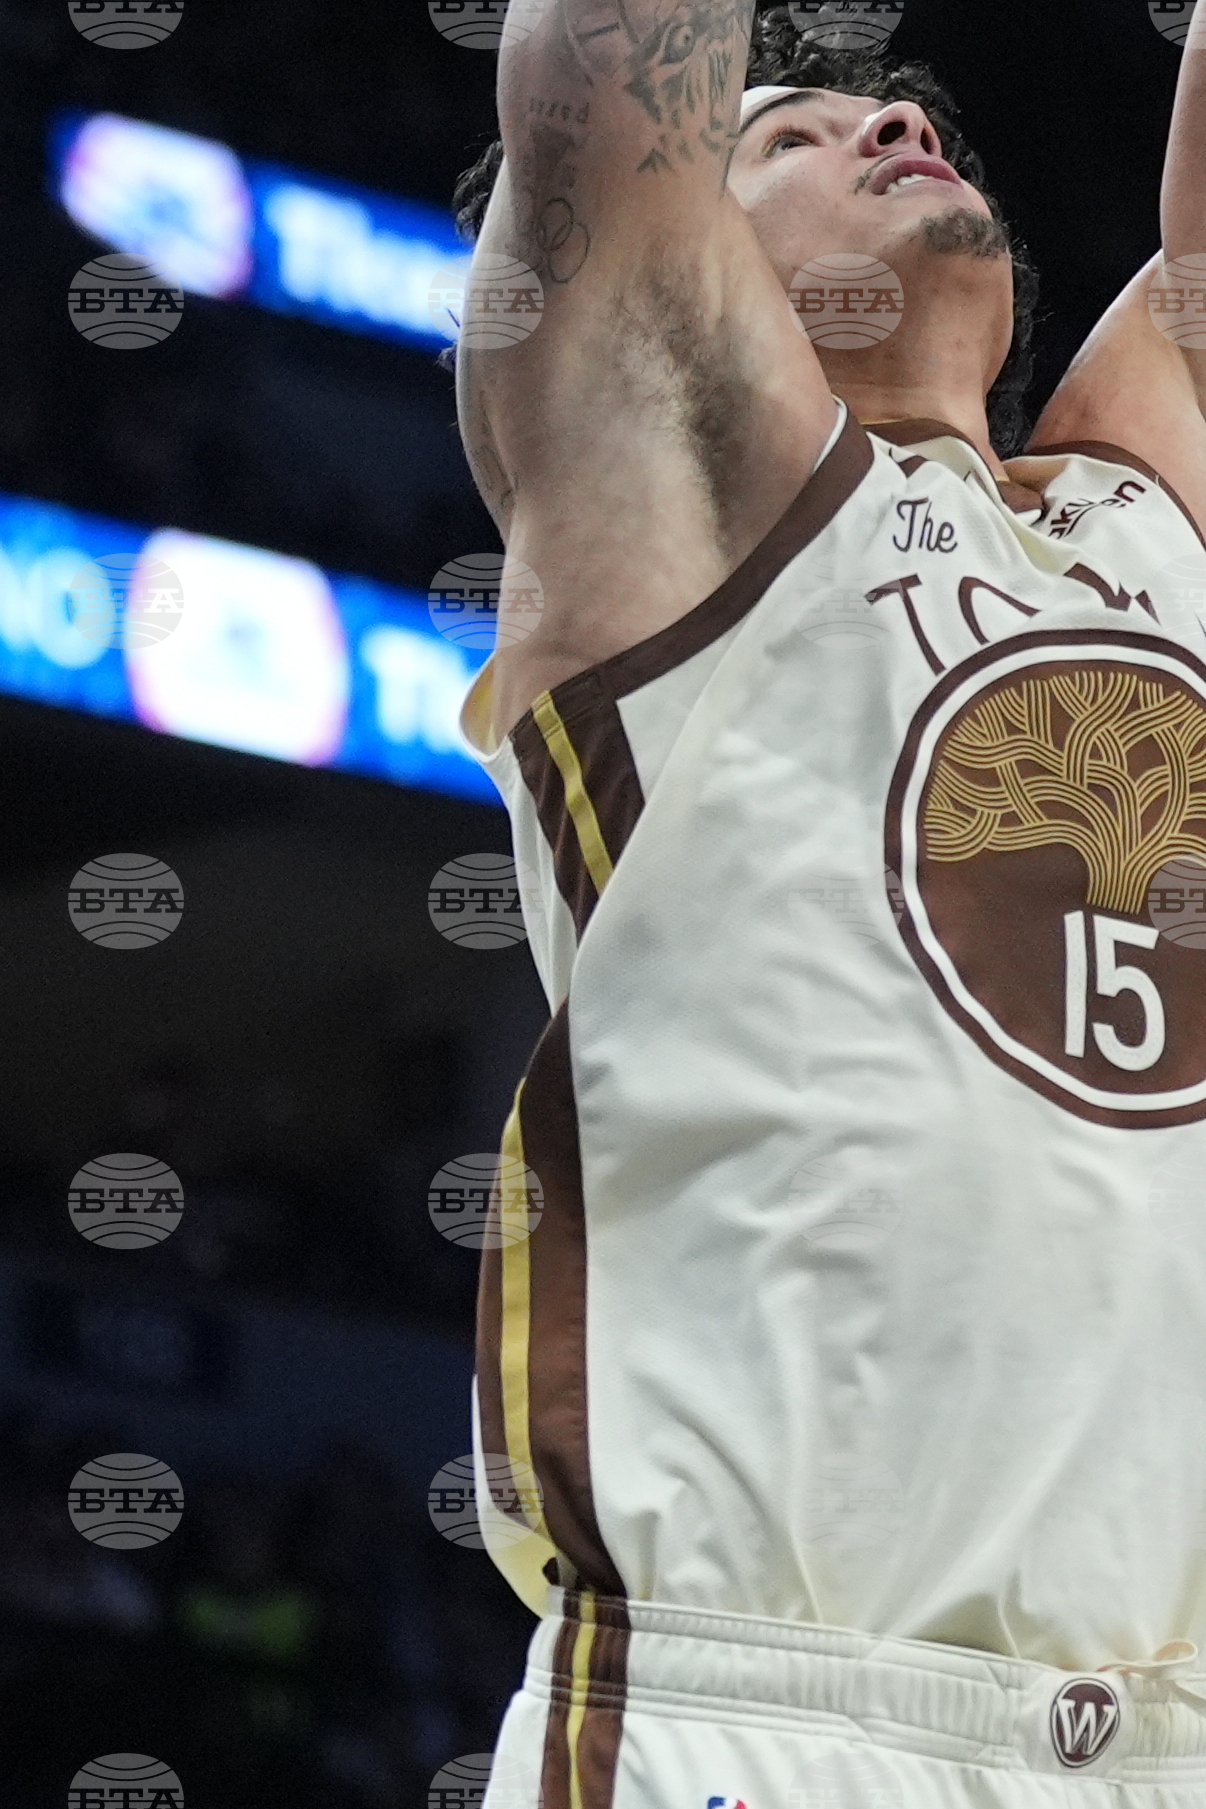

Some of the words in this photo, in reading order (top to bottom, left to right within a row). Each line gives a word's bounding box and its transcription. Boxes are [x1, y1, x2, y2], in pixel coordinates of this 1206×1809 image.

[893, 496, 959, 553] The
[1063, 908, 1166, 1072] 15
[1055, 1697, 1119, 1757] W
